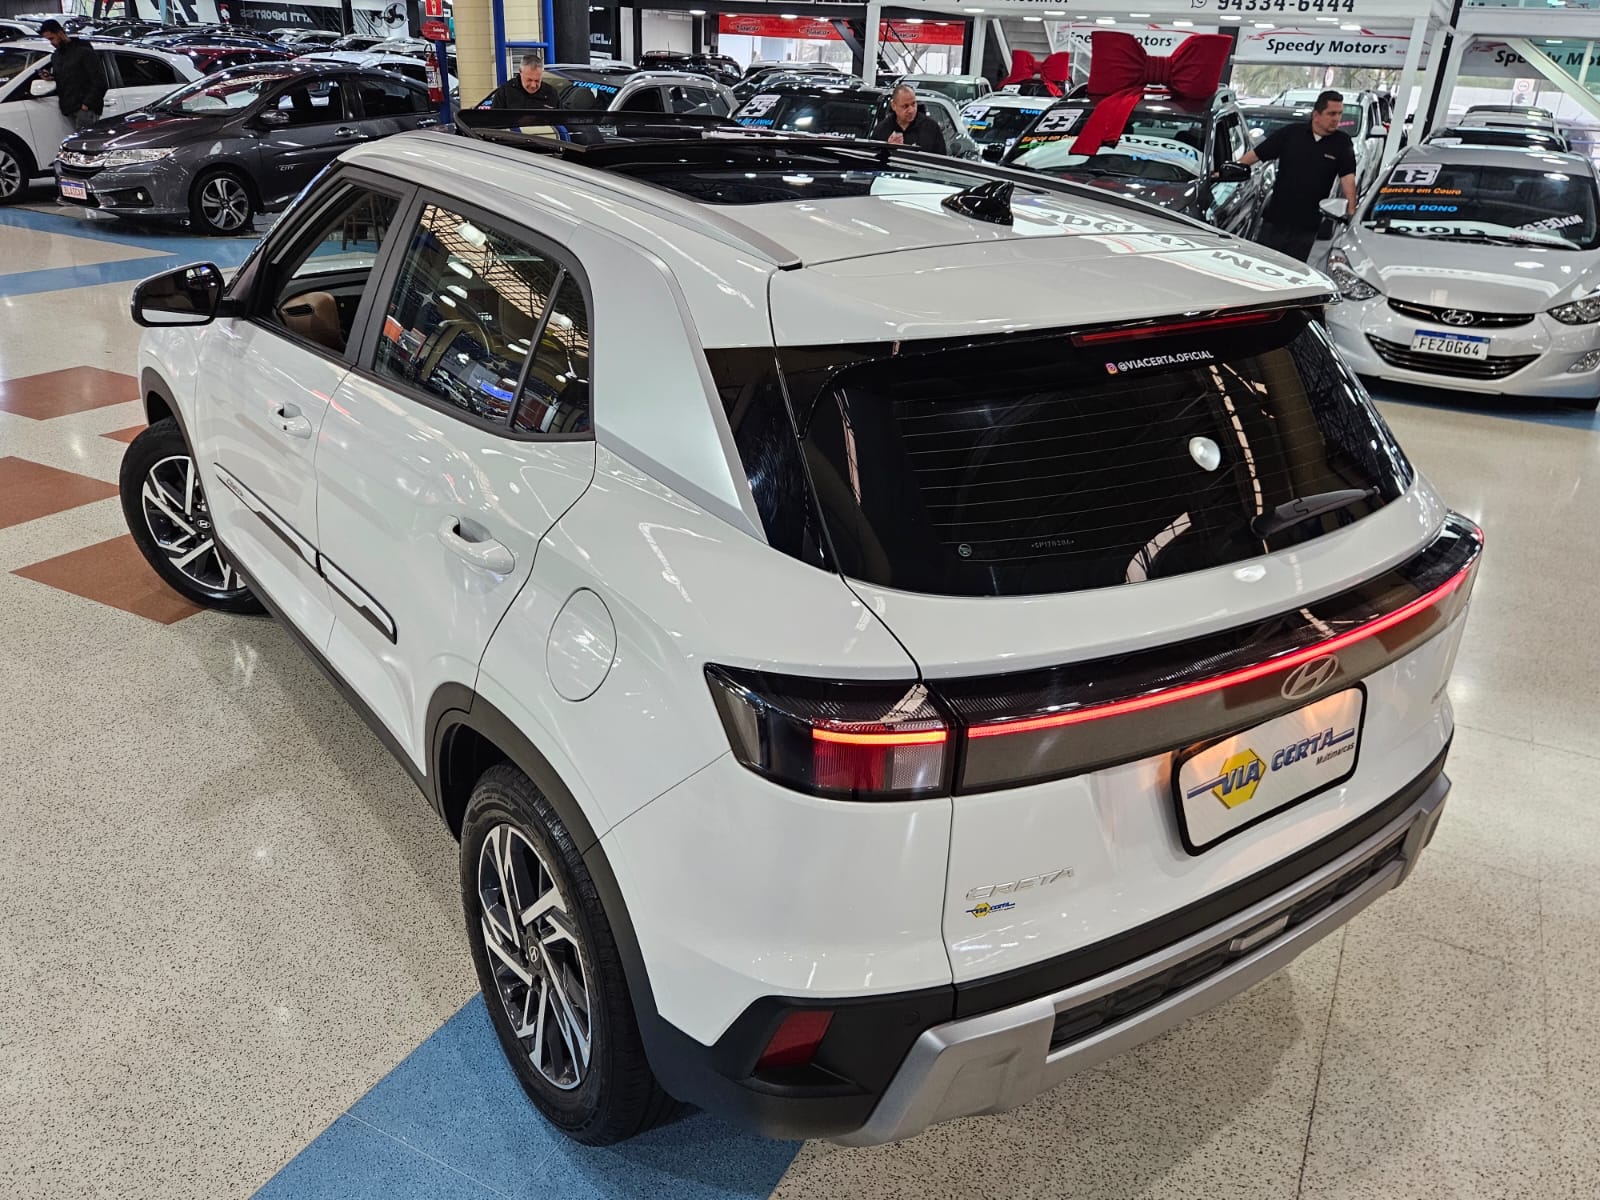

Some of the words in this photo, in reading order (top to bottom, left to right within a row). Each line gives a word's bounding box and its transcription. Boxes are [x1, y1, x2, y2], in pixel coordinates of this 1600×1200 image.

[1266, 39, 1324, 55] Speedy
[1328, 40, 1388, 54] Motors
[1379, 187, 1415, 195] Bancos
[1432, 187, 1463, 196] Couro
[1418, 203, 1459, 213] DONO
[1117, 350, 1215, 373] @VIACERTA.OFICIAL
[1271, 727, 1336, 772] CERTA
[1315, 742, 1355, 767] Multimarcas
[965, 866, 1075, 900] CRETA
